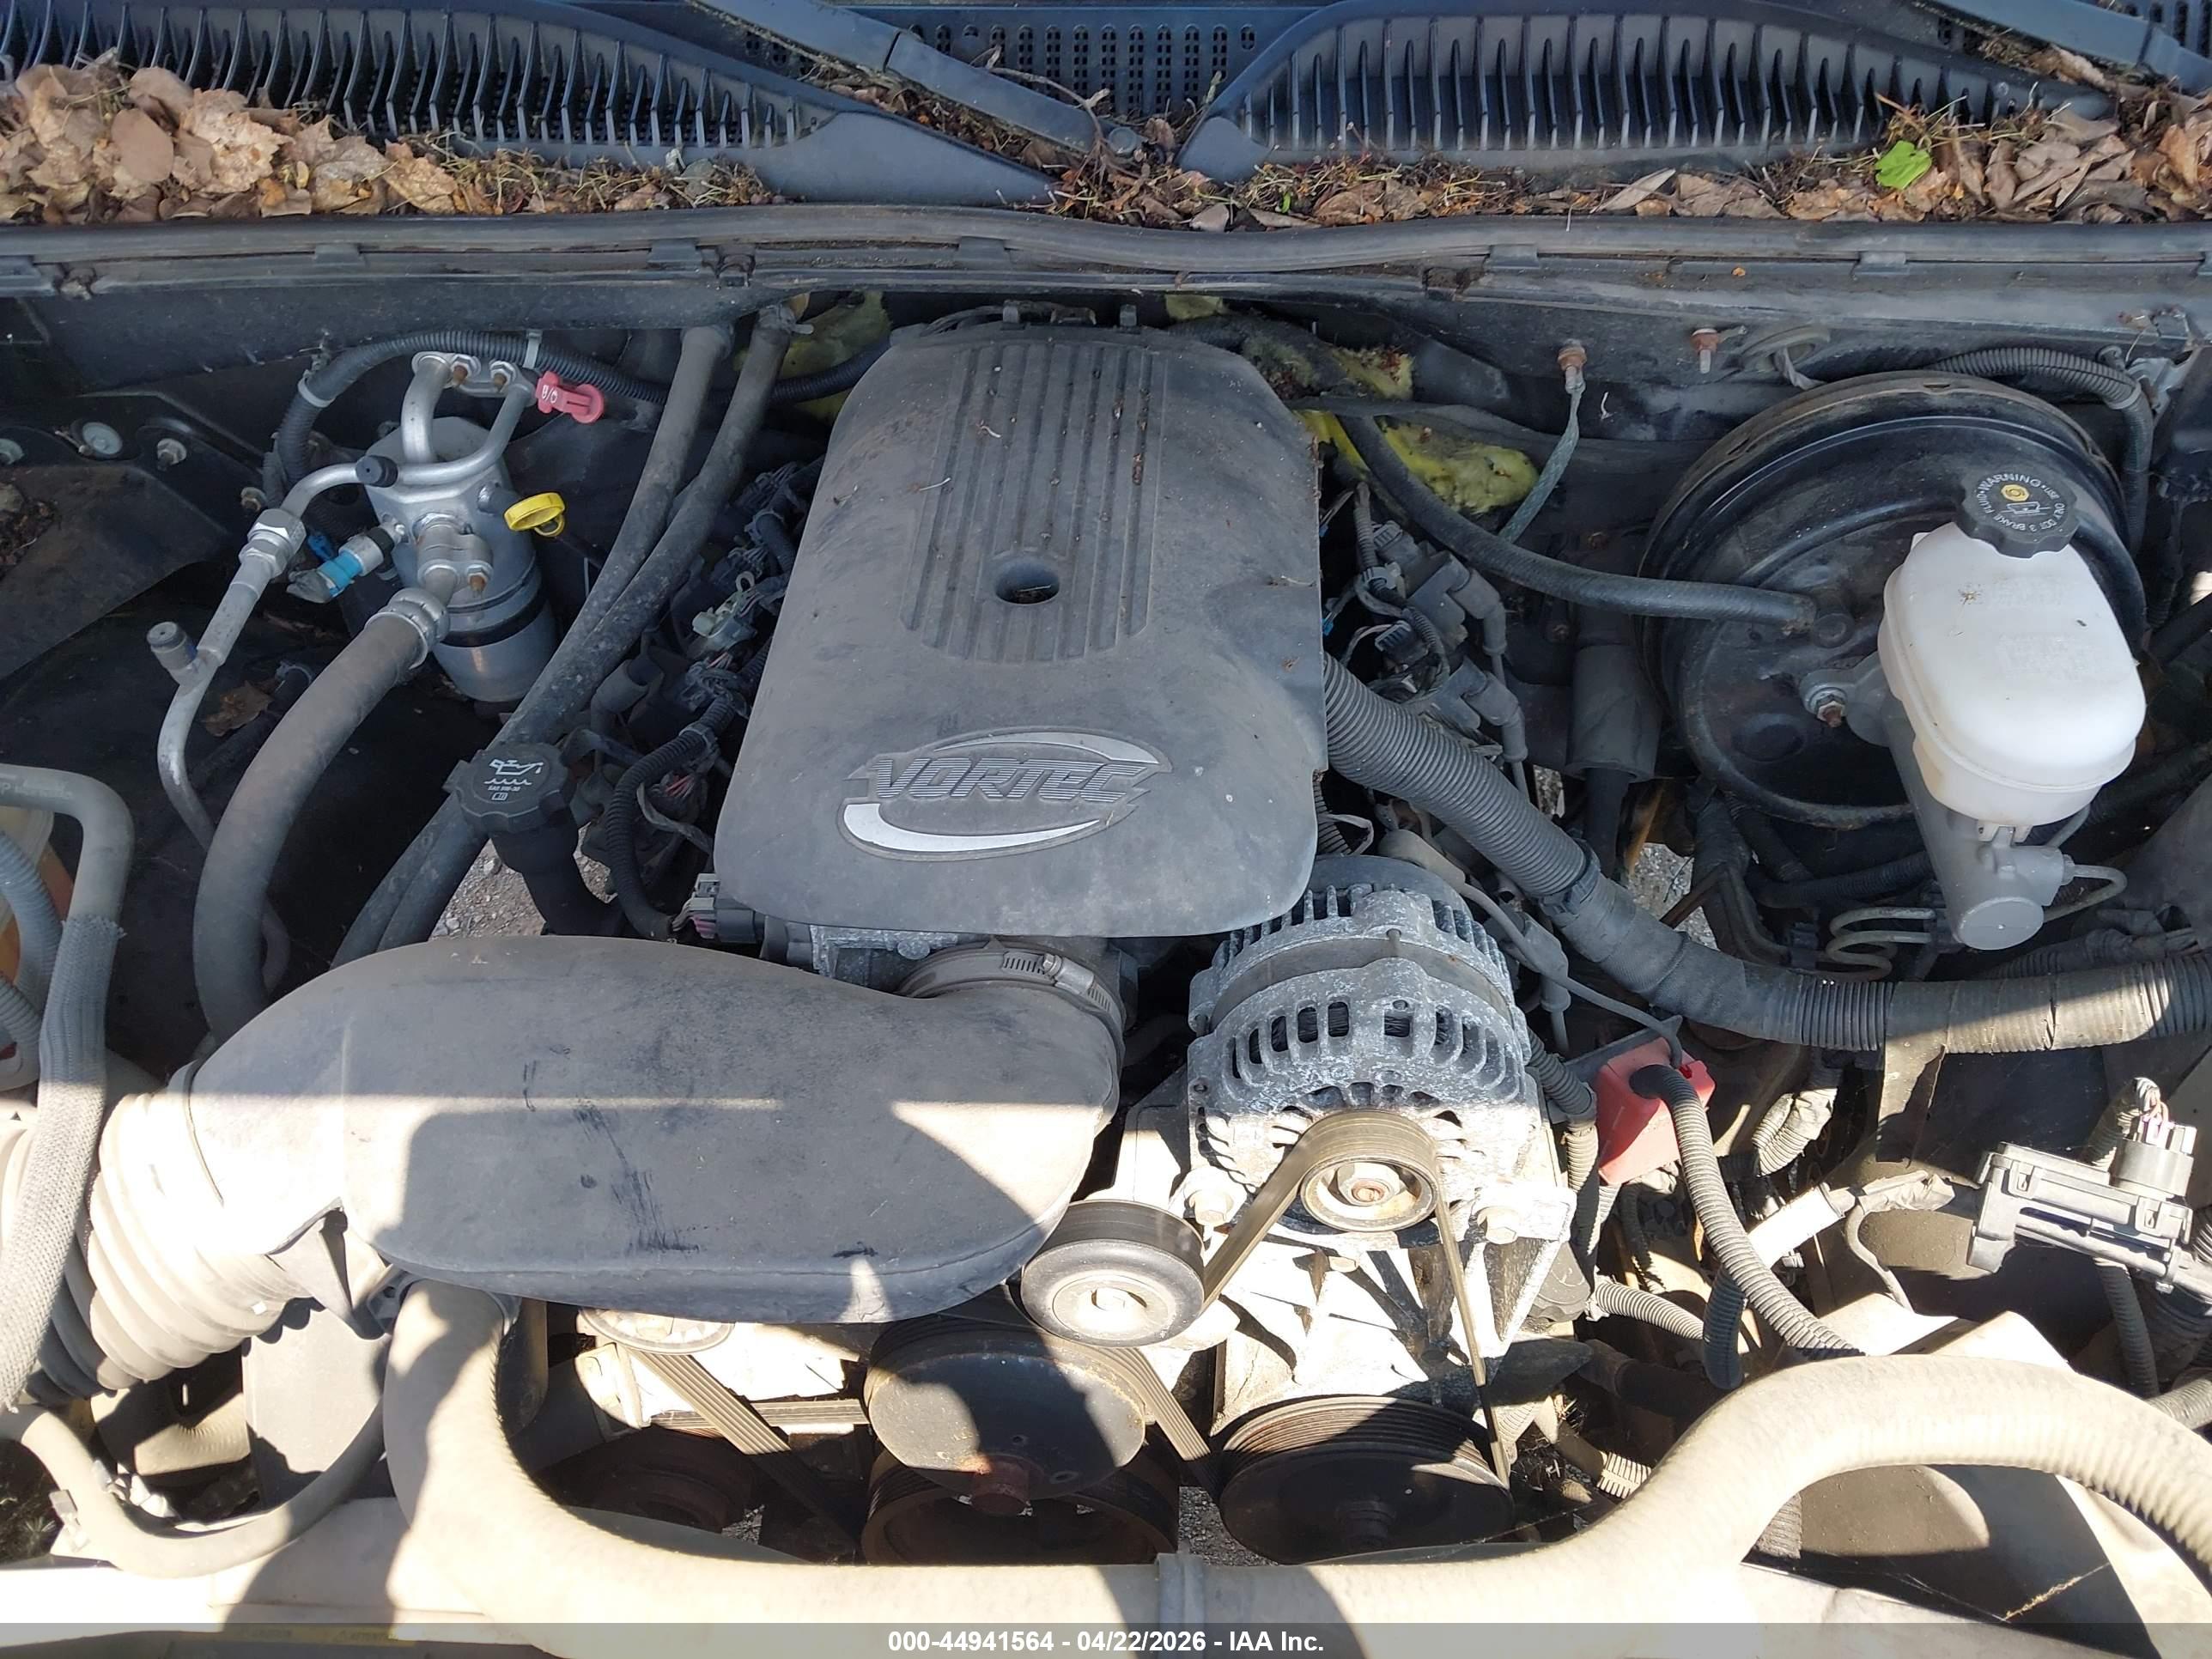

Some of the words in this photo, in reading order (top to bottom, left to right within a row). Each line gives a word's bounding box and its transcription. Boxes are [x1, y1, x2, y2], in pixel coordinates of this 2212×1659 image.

[1978, 473, 2043, 491] WARNING
[2043, 486, 2061, 500] USE
[1976, 493, 1996, 514] FLUID
[1993, 513, 2027, 531] BRAKE
[2028, 524, 2038, 532] 3
[870, 757, 1149, 803] VORTEC
